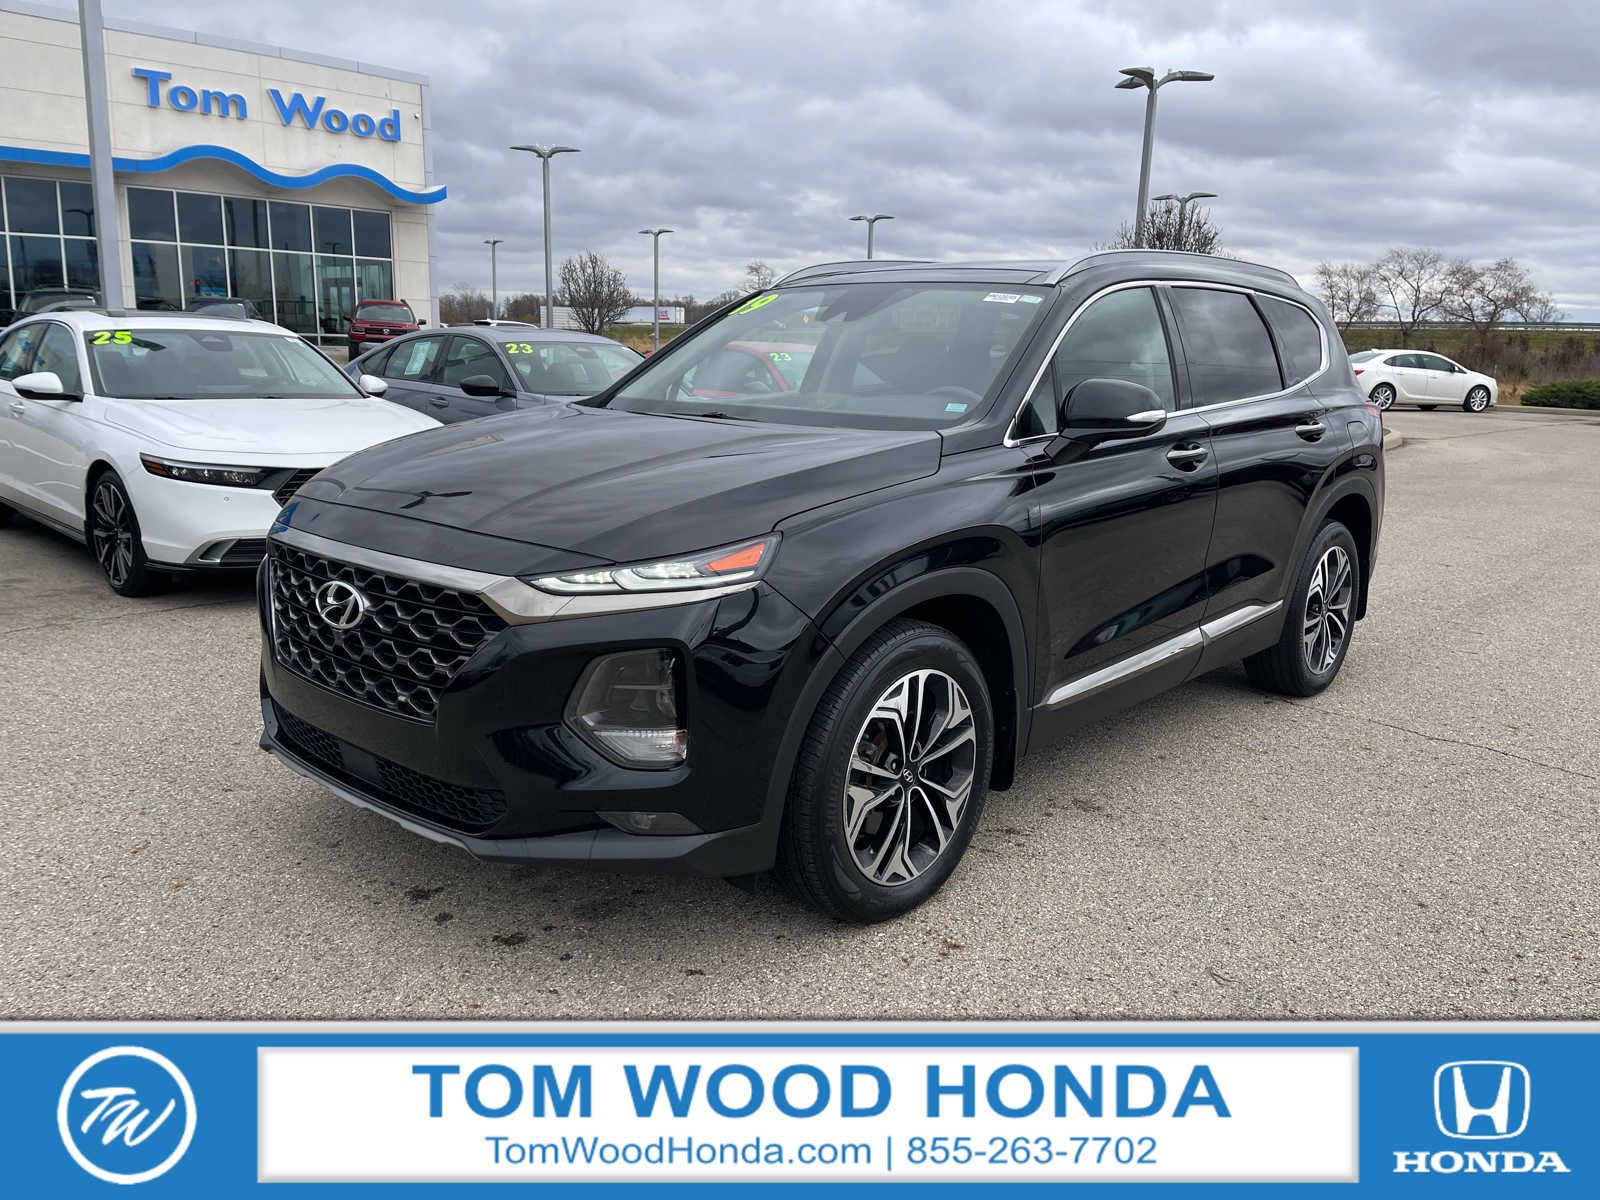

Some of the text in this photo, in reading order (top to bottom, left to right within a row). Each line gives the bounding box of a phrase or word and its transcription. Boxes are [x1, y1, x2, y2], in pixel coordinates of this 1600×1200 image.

[132, 67, 401, 142] Tom Wood
[728, 293, 779, 315] 19
[92, 330, 132, 345] 25
[505, 343, 533, 354] 23
[769, 352, 792, 362] 23
